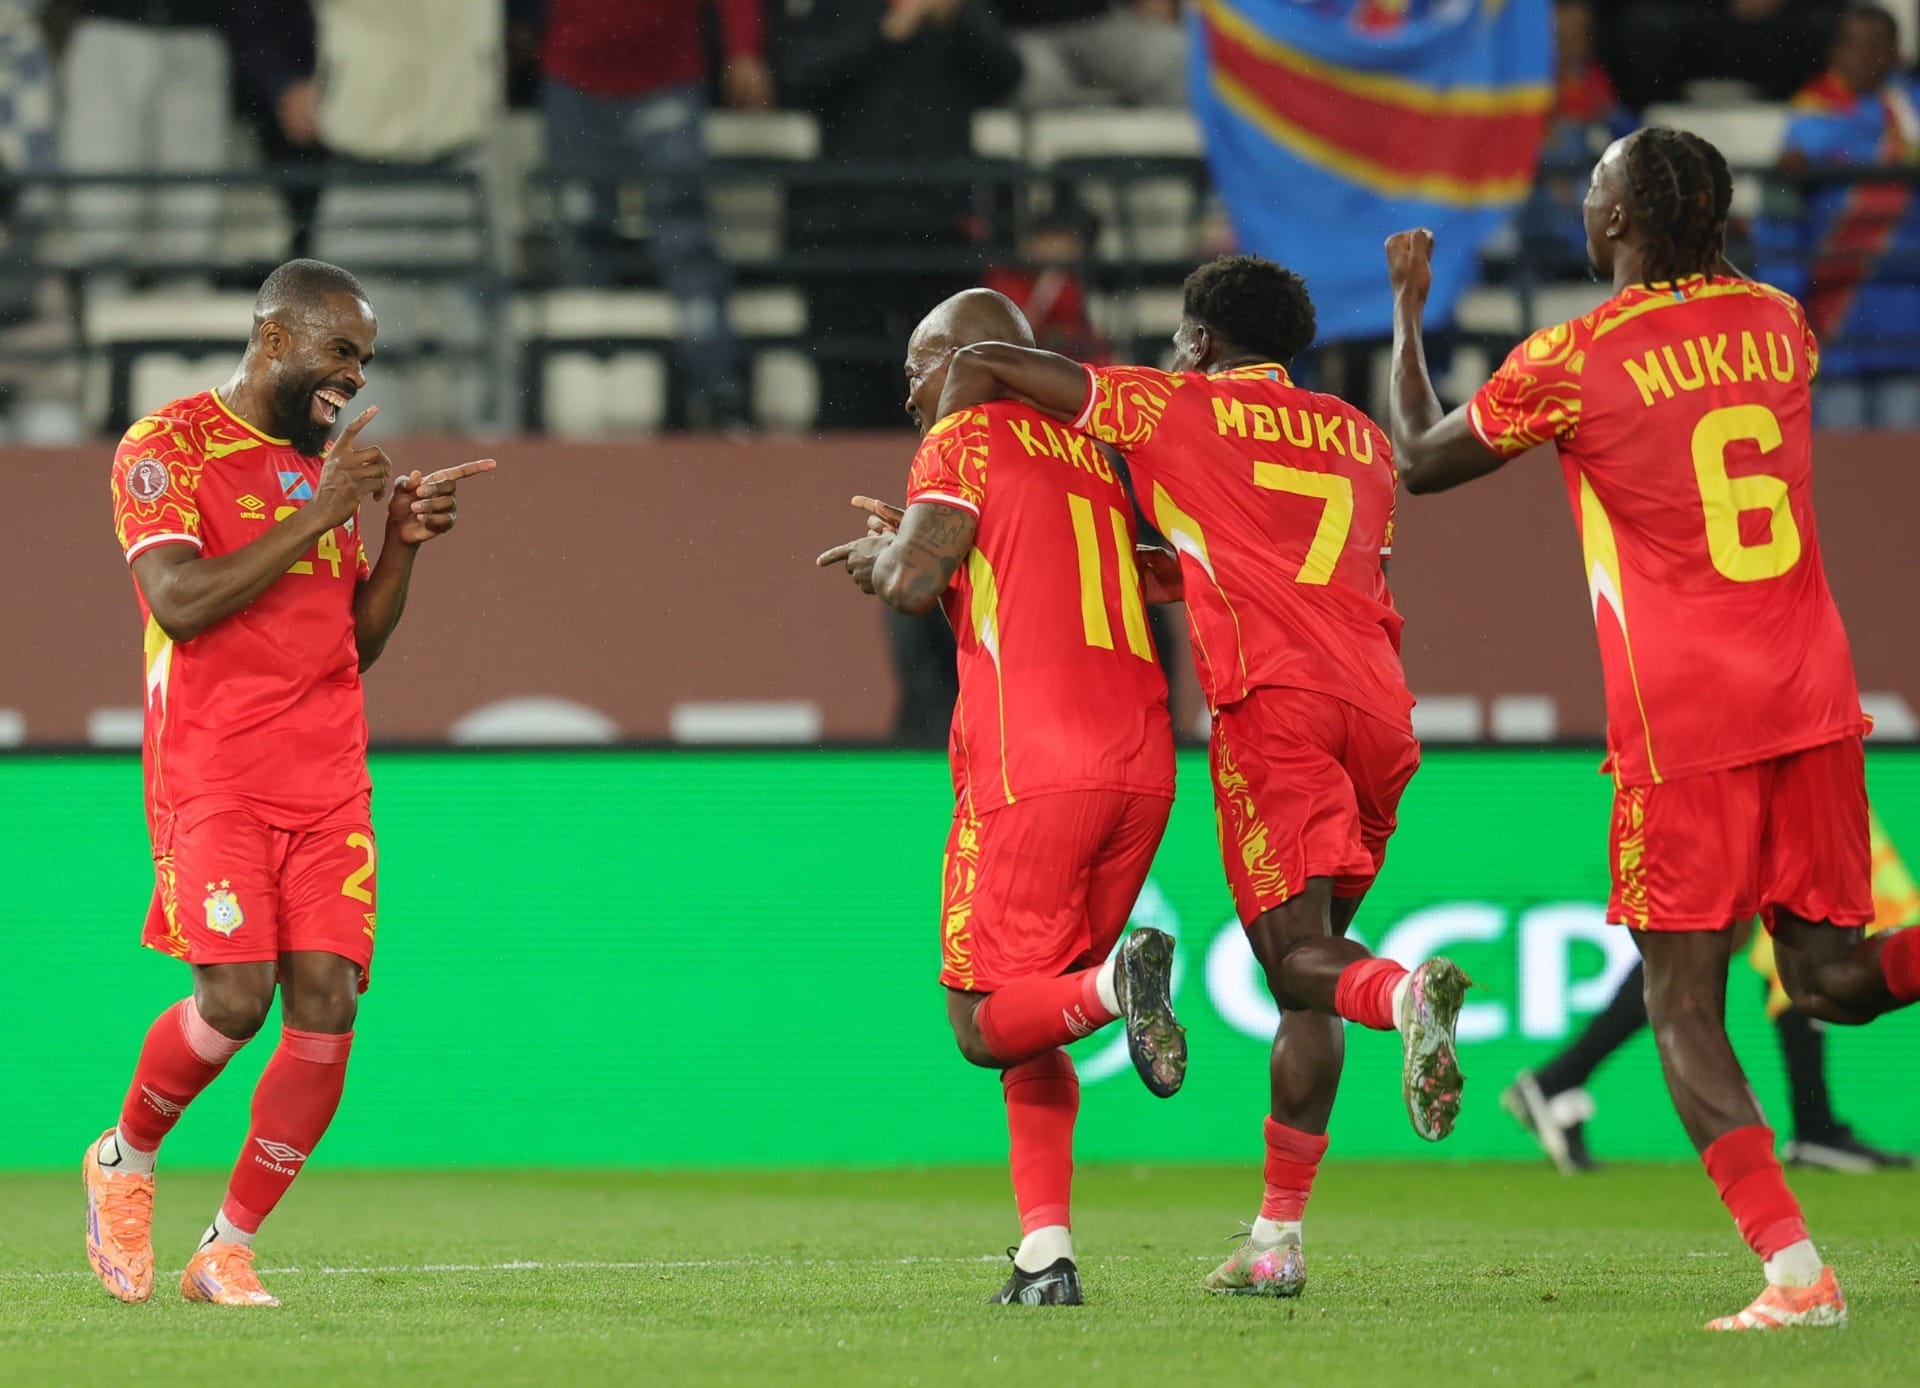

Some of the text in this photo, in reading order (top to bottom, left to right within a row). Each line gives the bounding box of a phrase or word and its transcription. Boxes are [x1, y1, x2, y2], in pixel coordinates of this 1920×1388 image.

[1622, 331, 1795, 406] MUKAU
[1211, 397, 1374, 464] MBUKU
[240, 511, 266, 520] umbro
[1253, 461, 1354, 585] 7
[1691, 404, 1801, 582] 6
[1067, 492, 1153, 662] 11
[341, 832, 375, 905] 2
[255, 1154, 296, 1176] umbro
